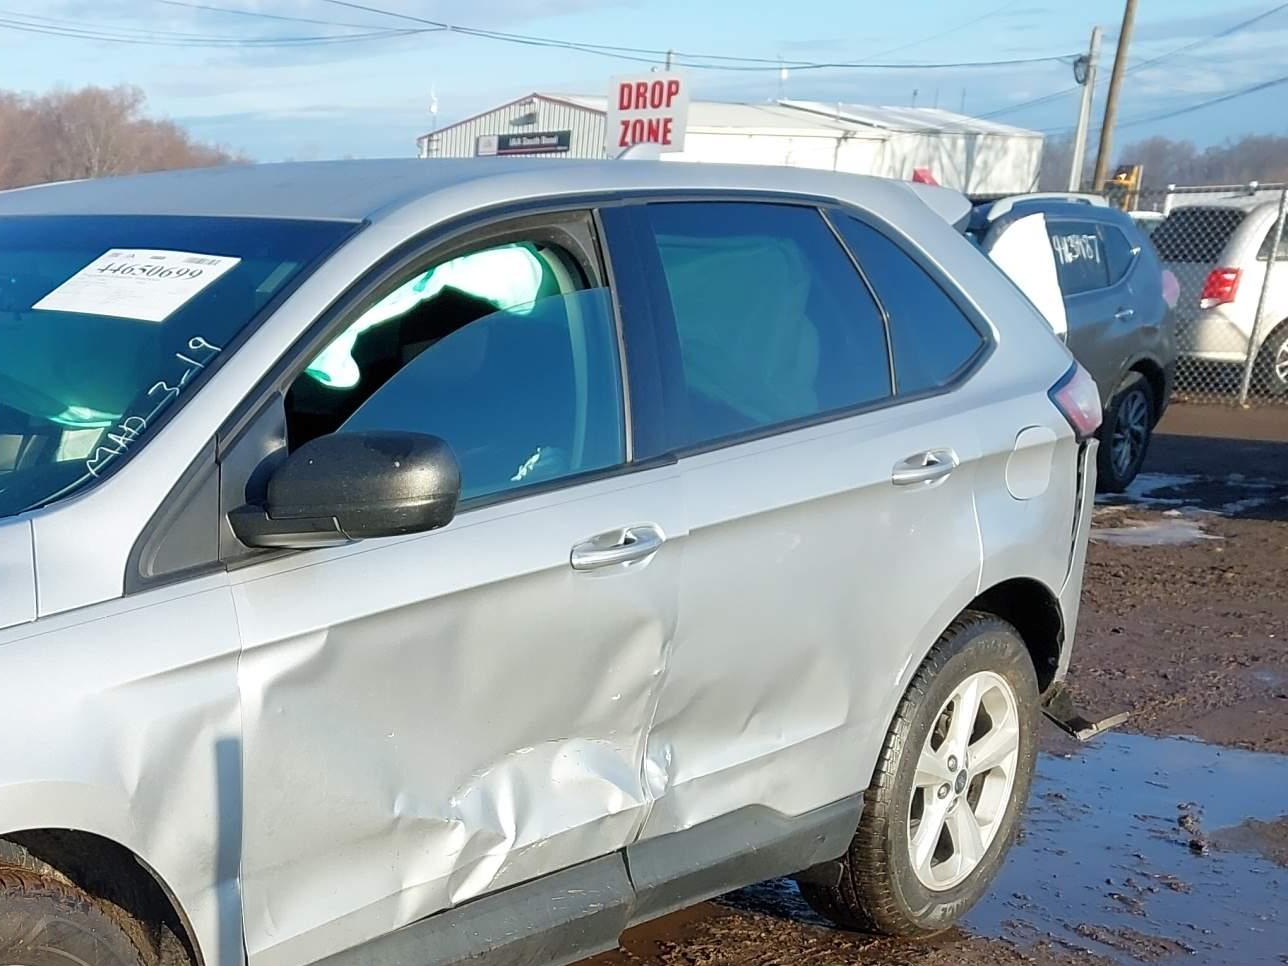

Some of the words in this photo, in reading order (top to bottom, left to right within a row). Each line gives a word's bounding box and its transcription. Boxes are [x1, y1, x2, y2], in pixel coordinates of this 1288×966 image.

[618, 79, 680, 110] DROP
[618, 117, 673, 147] ZONE
[97, 262, 204, 281] 44650699
[147, 336, 223, 397] 3-19
